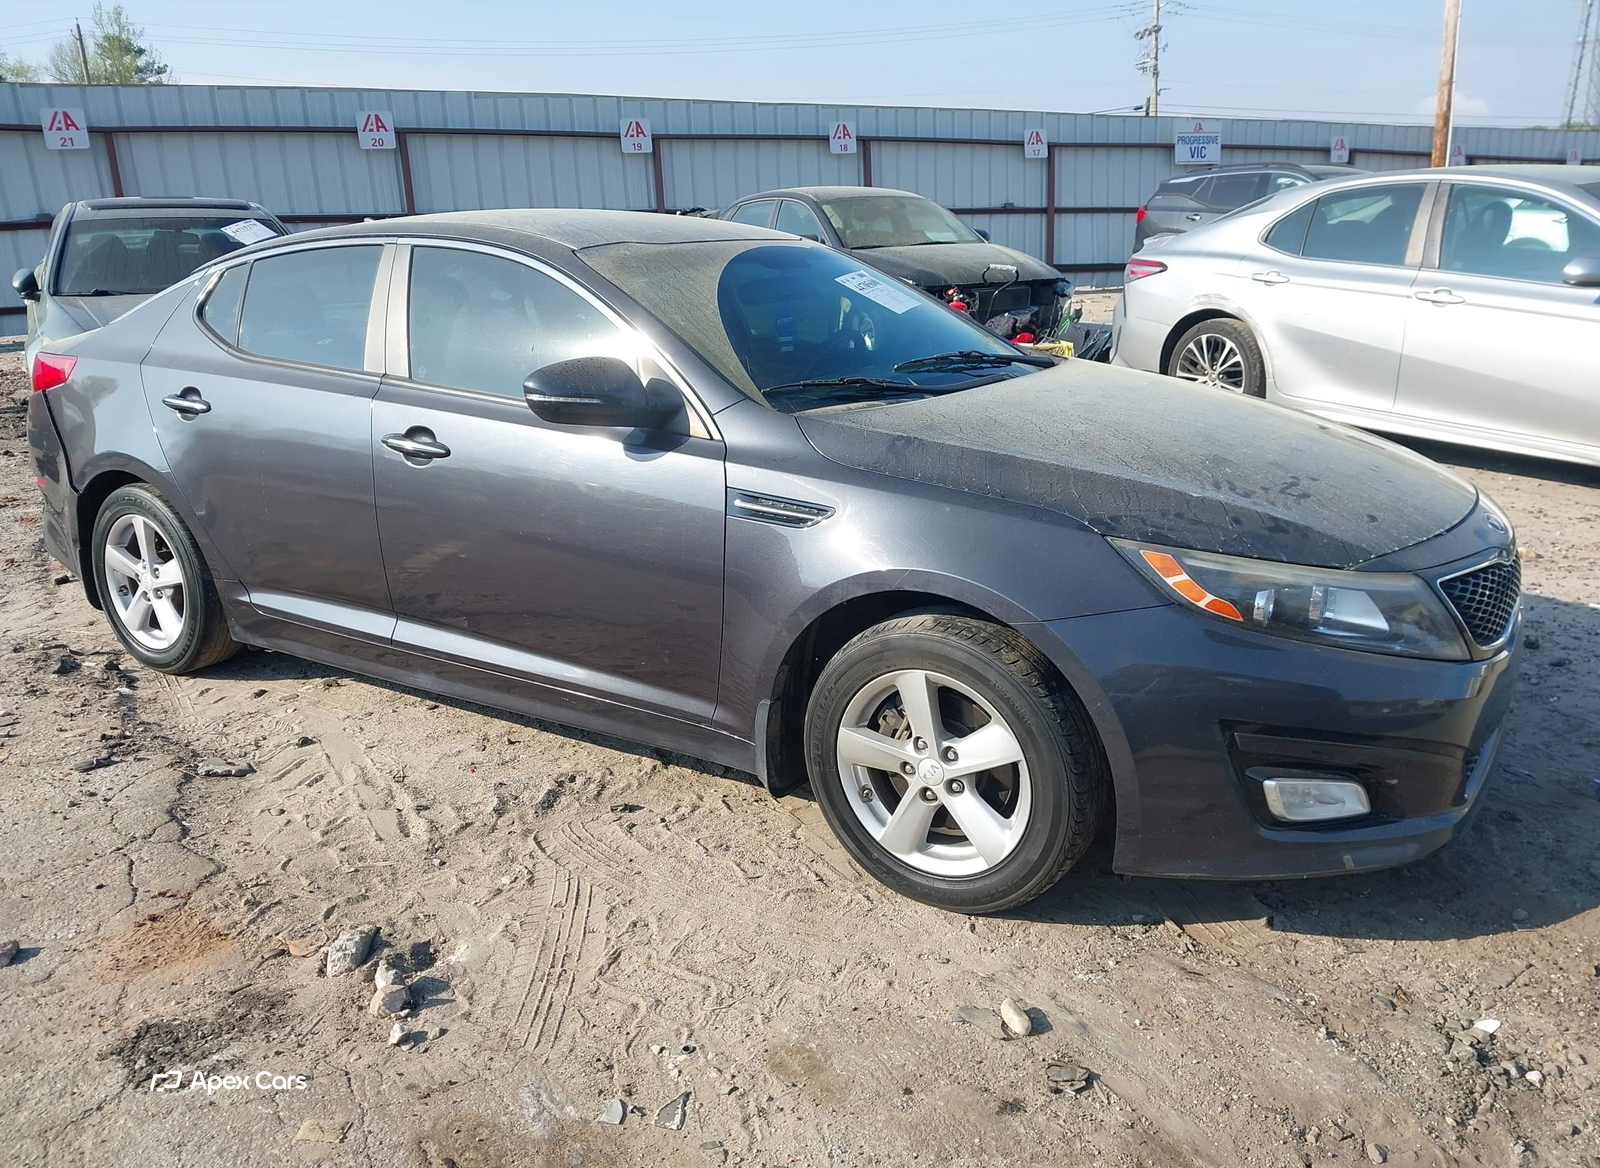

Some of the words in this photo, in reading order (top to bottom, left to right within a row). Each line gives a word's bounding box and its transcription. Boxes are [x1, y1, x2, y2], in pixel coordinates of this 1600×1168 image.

[59, 136, 75, 147] 21
[371, 137, 384, 147] 20
[1177, 134, 1219, 145] PROGRESSIVE
[632, 142, 643, 151] 19
[839, 143, 848, 152] 18
[1032, 149, 1041, 157] 17
[1189, 145, 1207, 159] VIC
